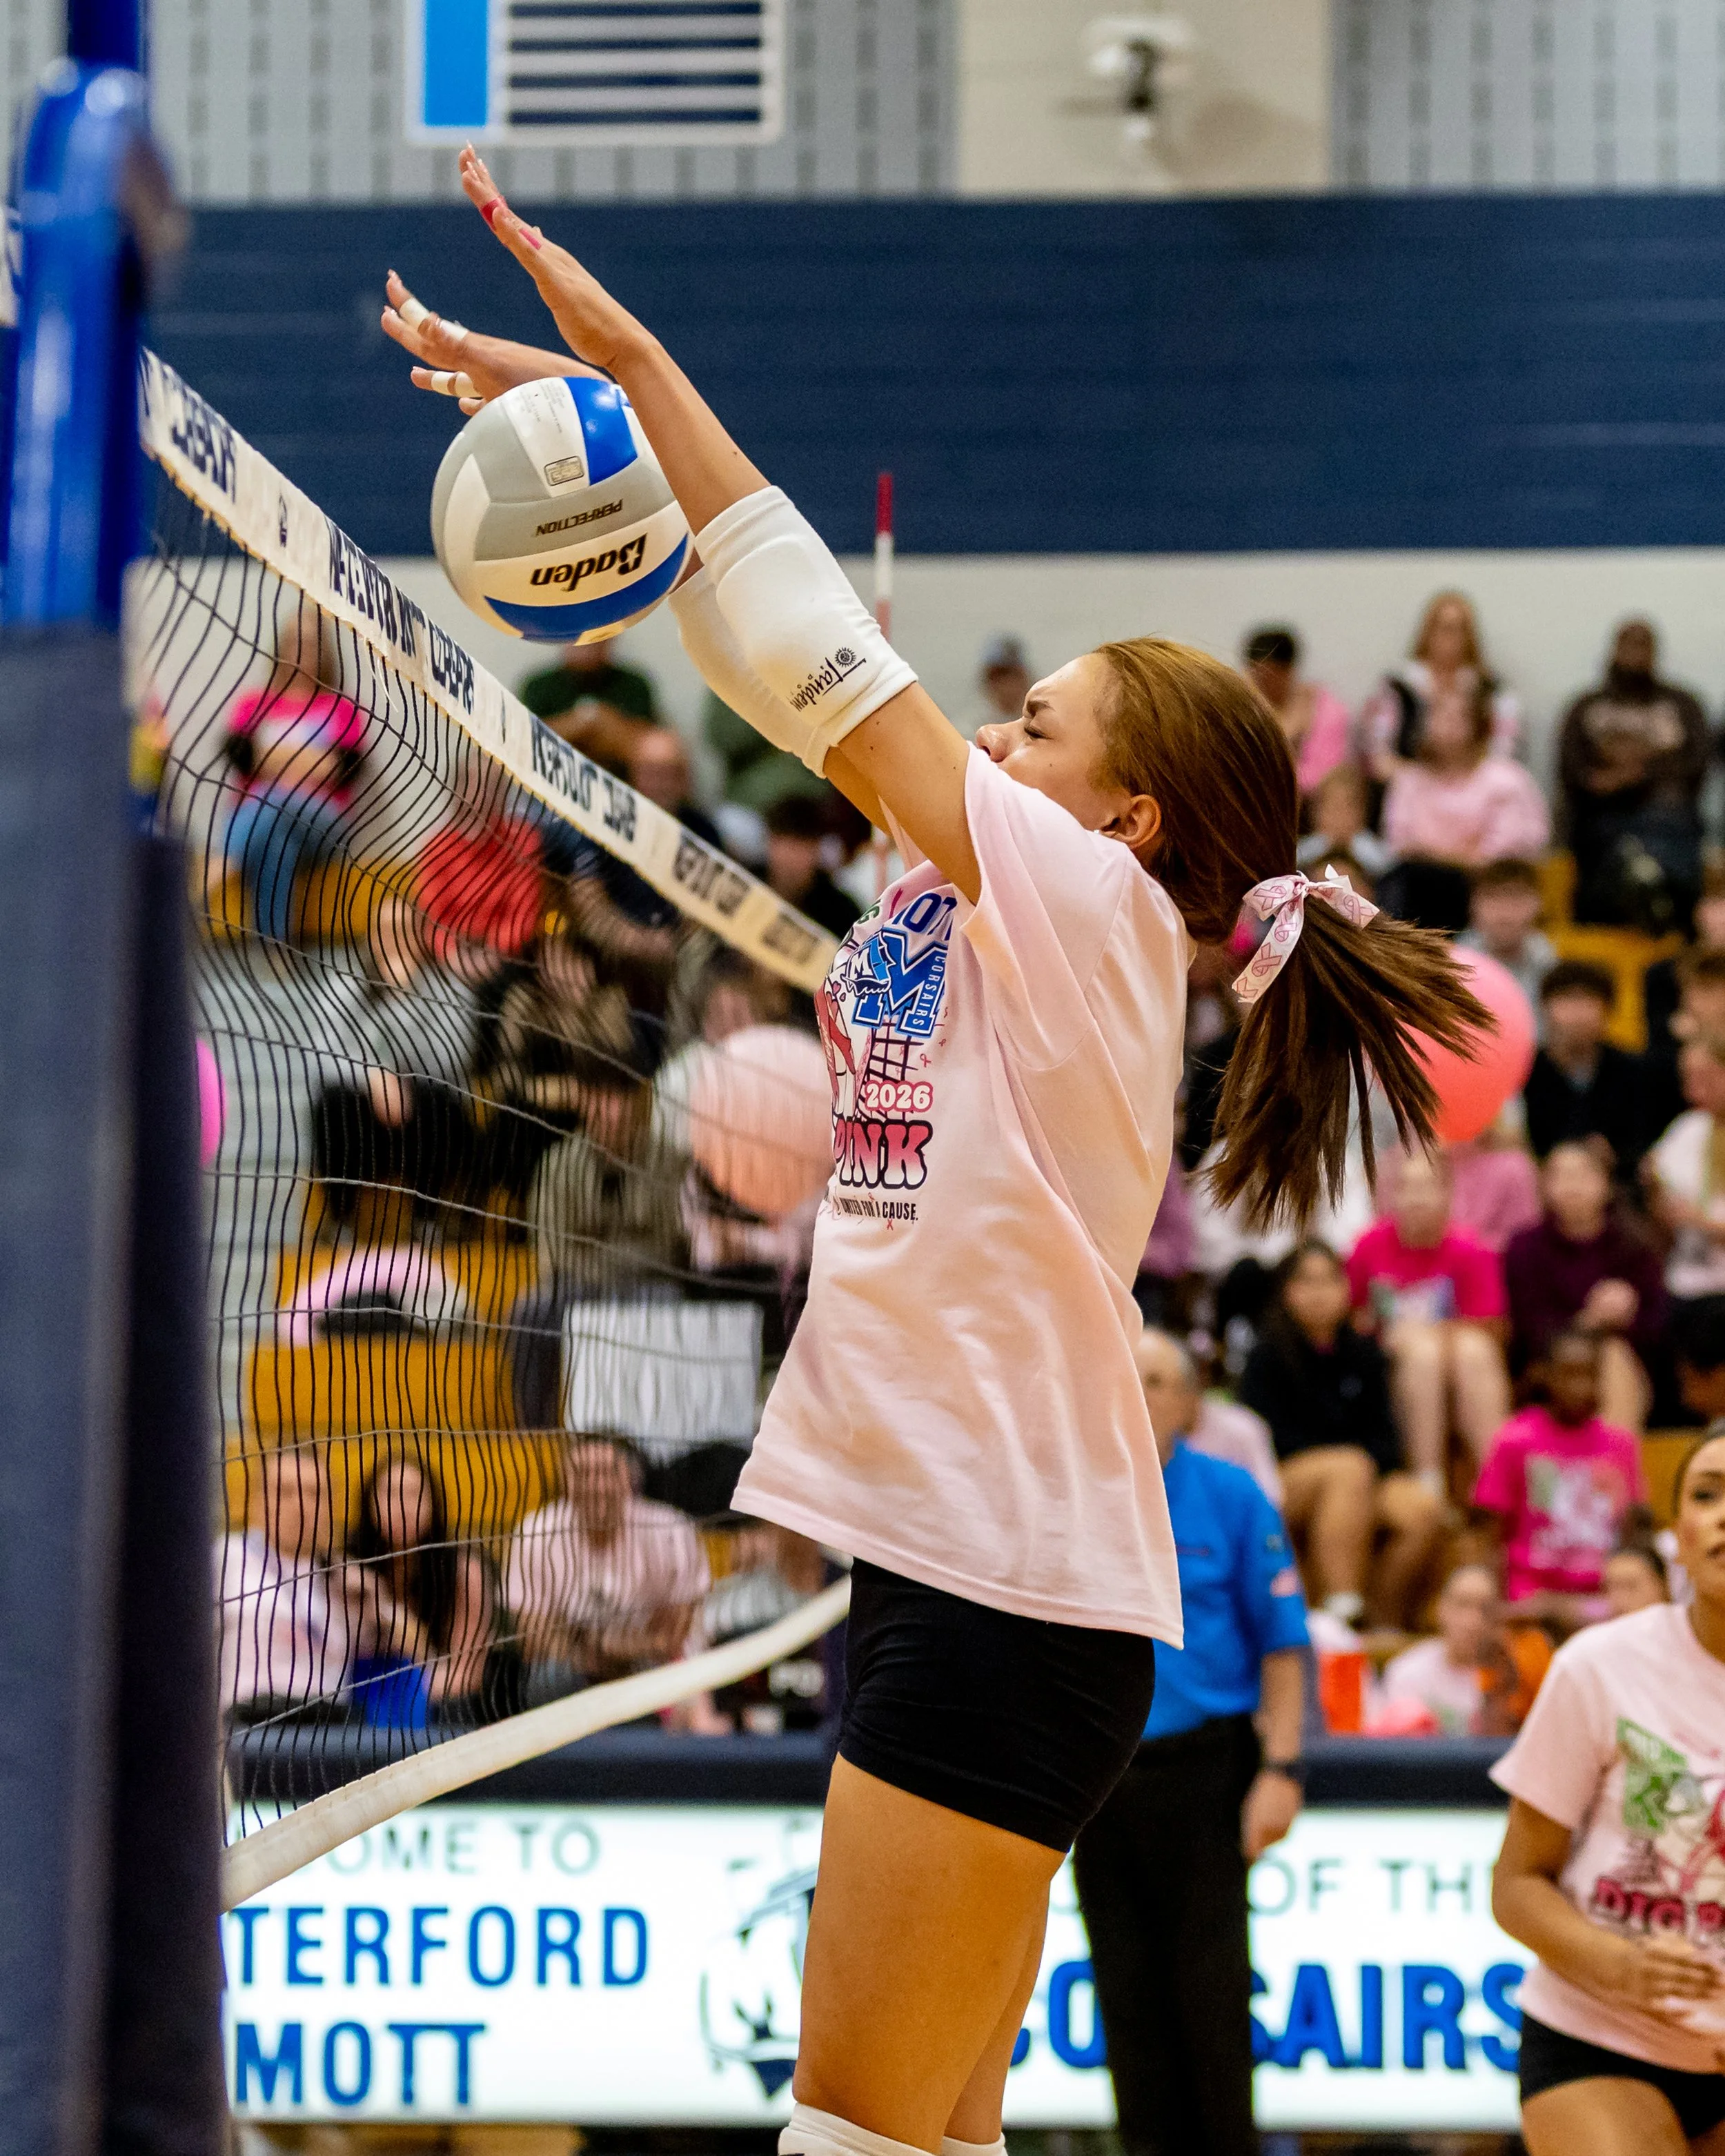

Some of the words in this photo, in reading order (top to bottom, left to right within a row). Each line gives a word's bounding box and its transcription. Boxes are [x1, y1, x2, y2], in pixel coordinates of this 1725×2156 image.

[535, 498, 623, 537] PERFECTION
[529, 533, 648, 592] Baden
[787, 657, 867, 712] Tandem
[912, 956, 946, 1026] CORSAIRS
[865, 1081, 932, 1111] 2026
[882, 1201, 918, 1221] CAUSE.
[511, 1820, 600, 1875] TO
[1248, 1856, 1346, 1917] OF
[1380, 1856, 1492, 1915] TH
[229, 1905, 649, 1987] TERFORD
[236, 2021, 487, 2106] MOTT
